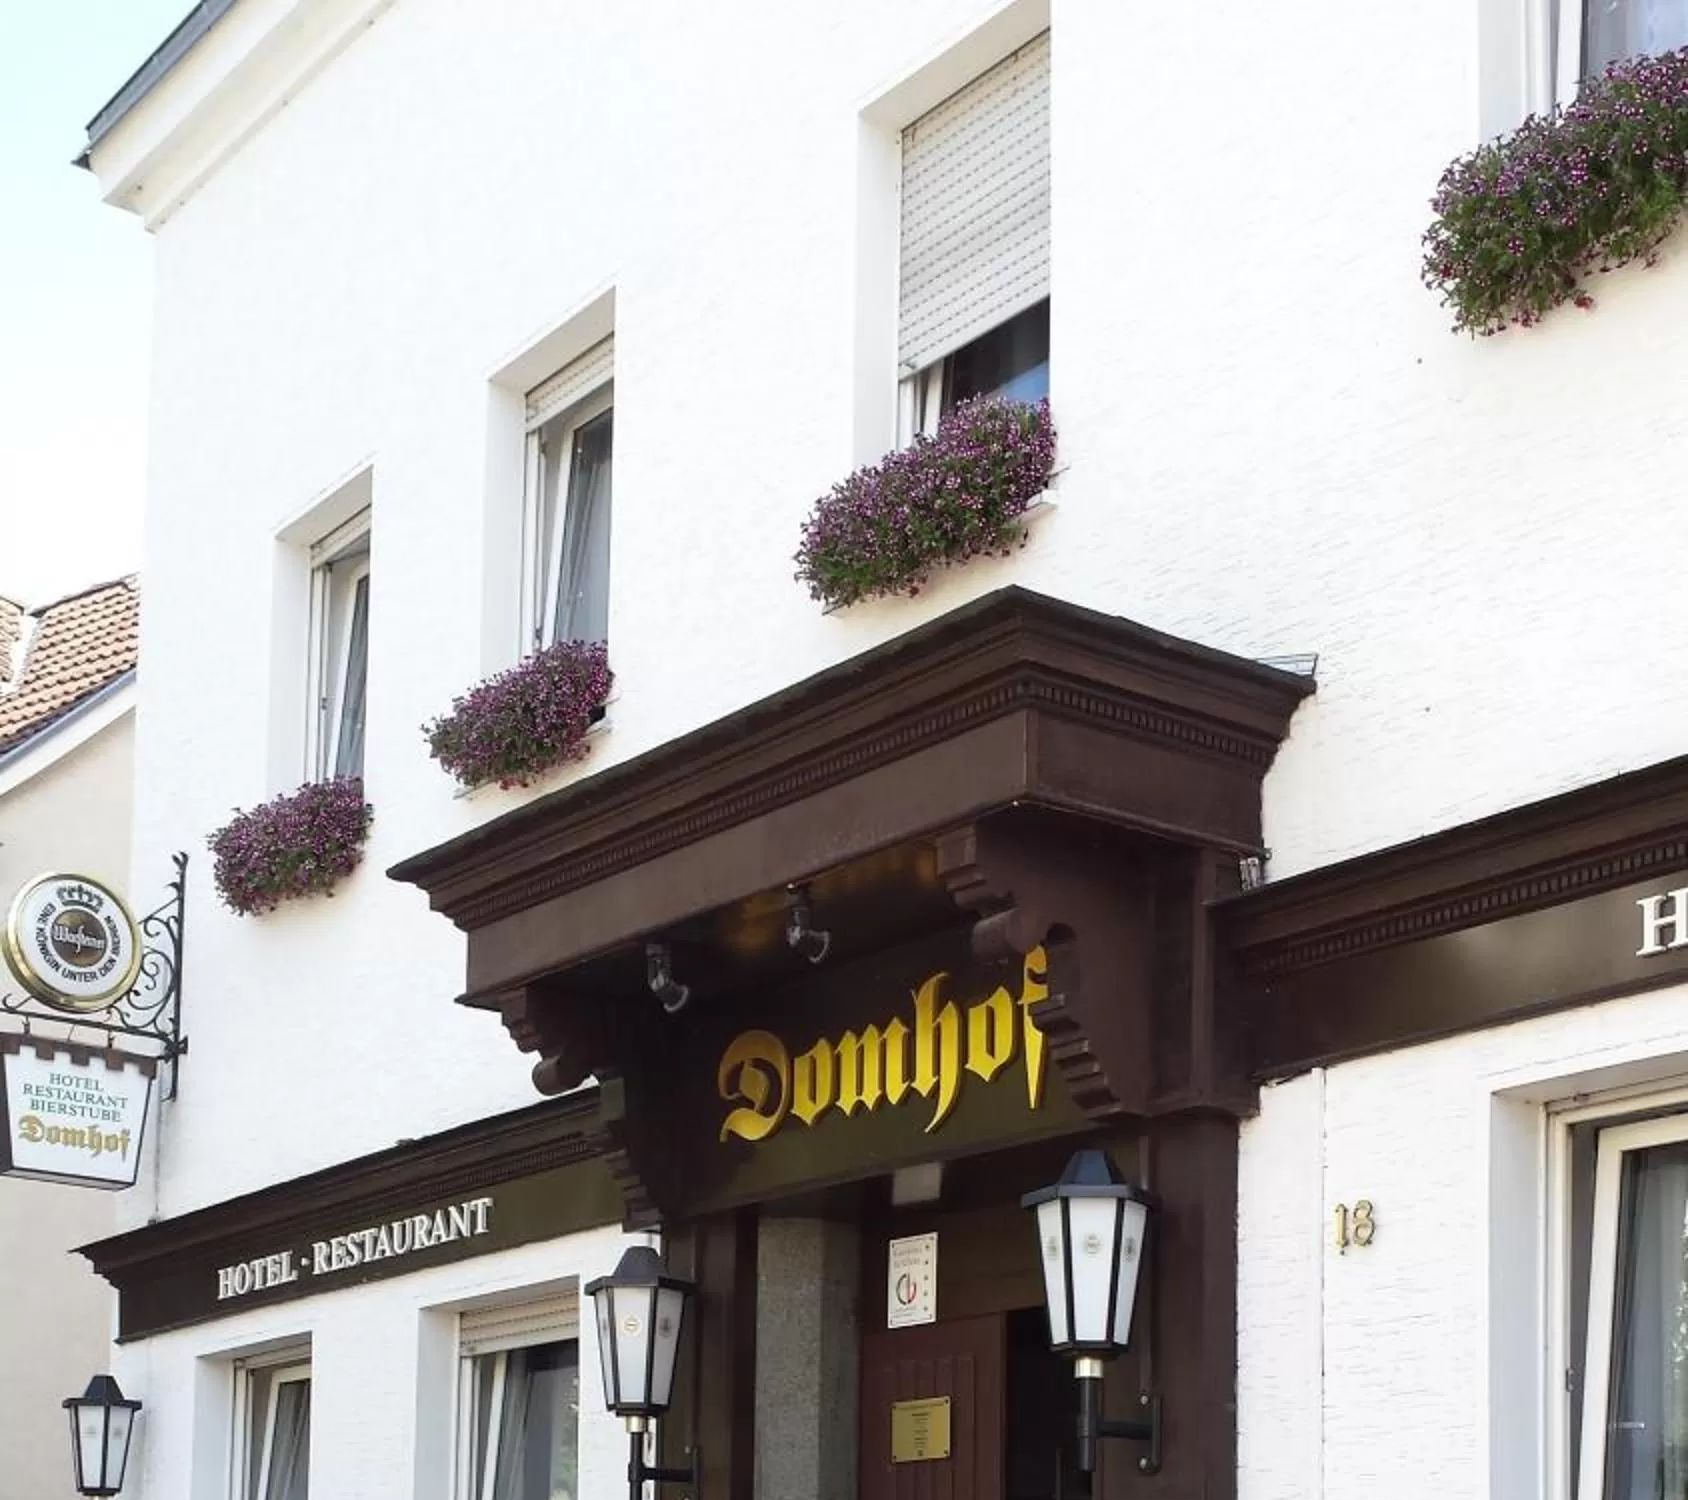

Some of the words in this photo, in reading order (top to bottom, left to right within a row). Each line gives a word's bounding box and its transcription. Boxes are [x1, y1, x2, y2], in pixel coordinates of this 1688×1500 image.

[62, 967, 98, 983] UNTER
[98, 957, 117, 977] DEN
[718, 944, 1049, 1143] Domhof
[23, 1083, 128, 1109] RESTAURANT
[49, 1073, 104, 1092] HOTEL
[30, 1098, 121, 1122] BIERSTUBE
[18, 1114, 131, 1163] Domhof
[1335, 1200, 1376, 1248] 18
[217, 1250, 299, 1300] HOTEL
[311, 1197, 494, 1275] RESTAURANT
